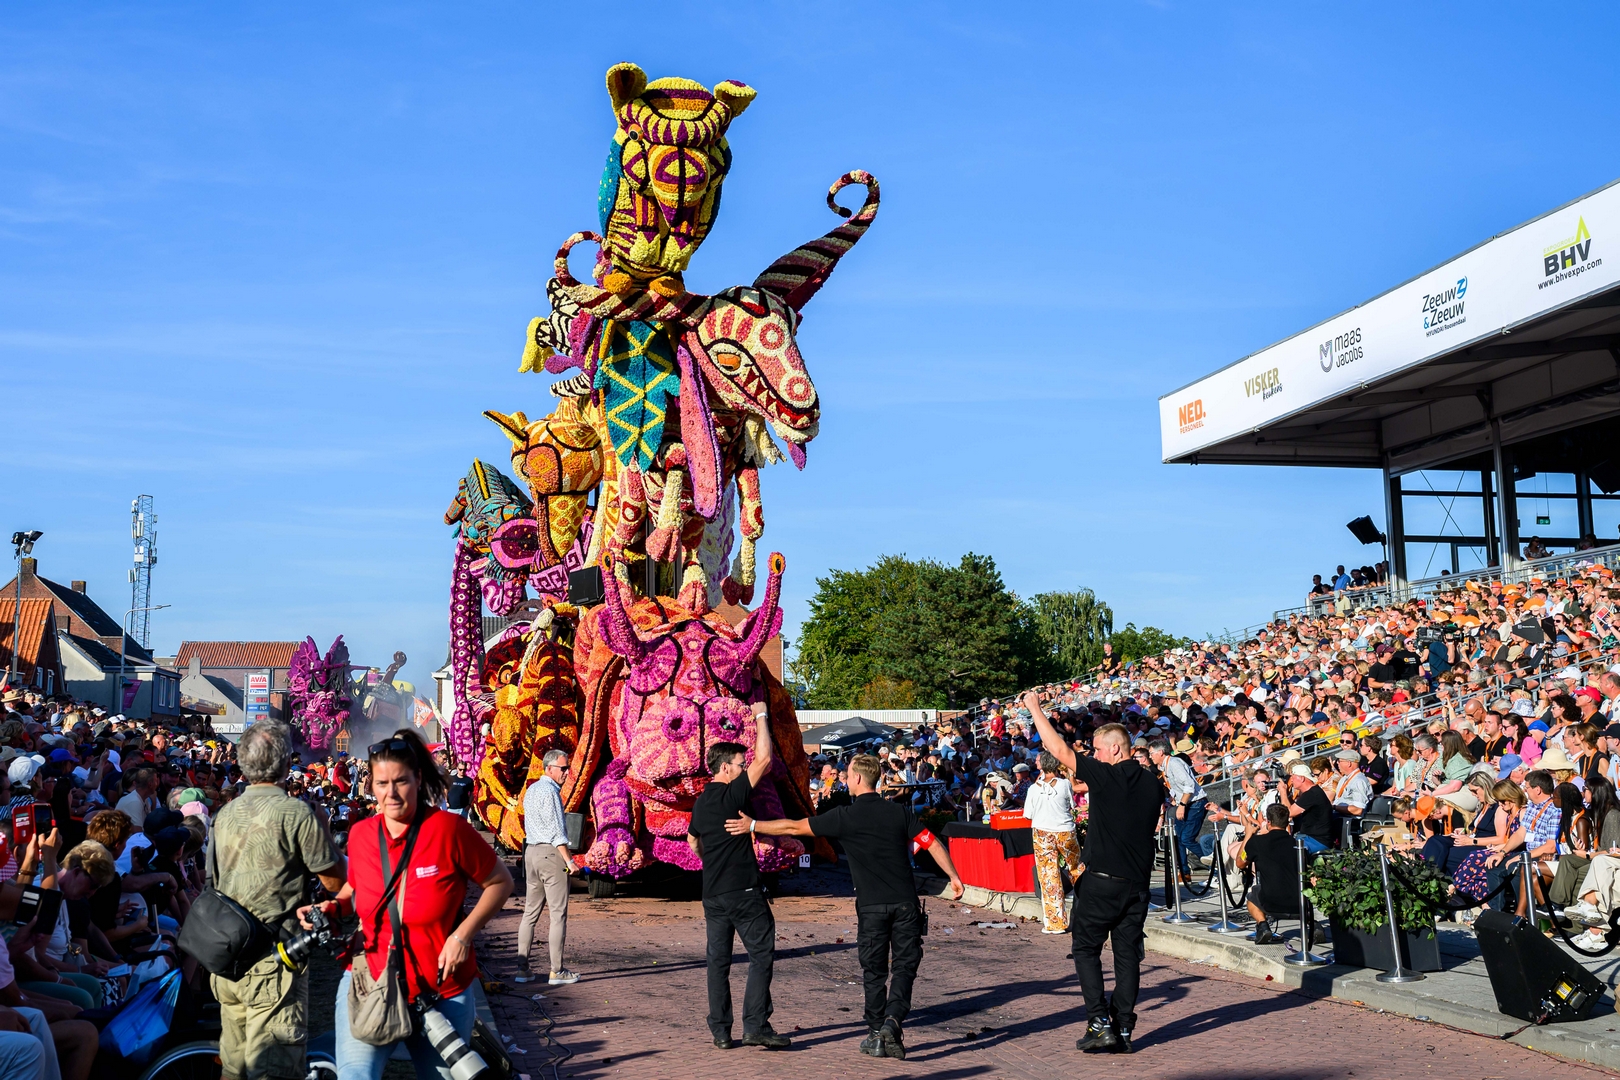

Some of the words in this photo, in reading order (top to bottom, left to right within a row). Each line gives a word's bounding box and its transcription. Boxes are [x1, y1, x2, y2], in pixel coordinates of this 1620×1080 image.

[1544, 238, 1591, 277] BHV
[1537, 258, 1603, 290] www.bhvexpo.com
[1422, 286, 1457, 313] Zeeuw
[1426, 325, 1444, 337] HYUNDAI
[1444, 316, 1466, 330] Roosendaal
[1430, 301, 1465, 327] Zeeuw
[1244, 367, 1280, 398] VISKER
[1178, 399, 1206, 427] NED.
[1180, 421, 1204, 434] PERSONEEL
[800, 855, 810, 863] 10
